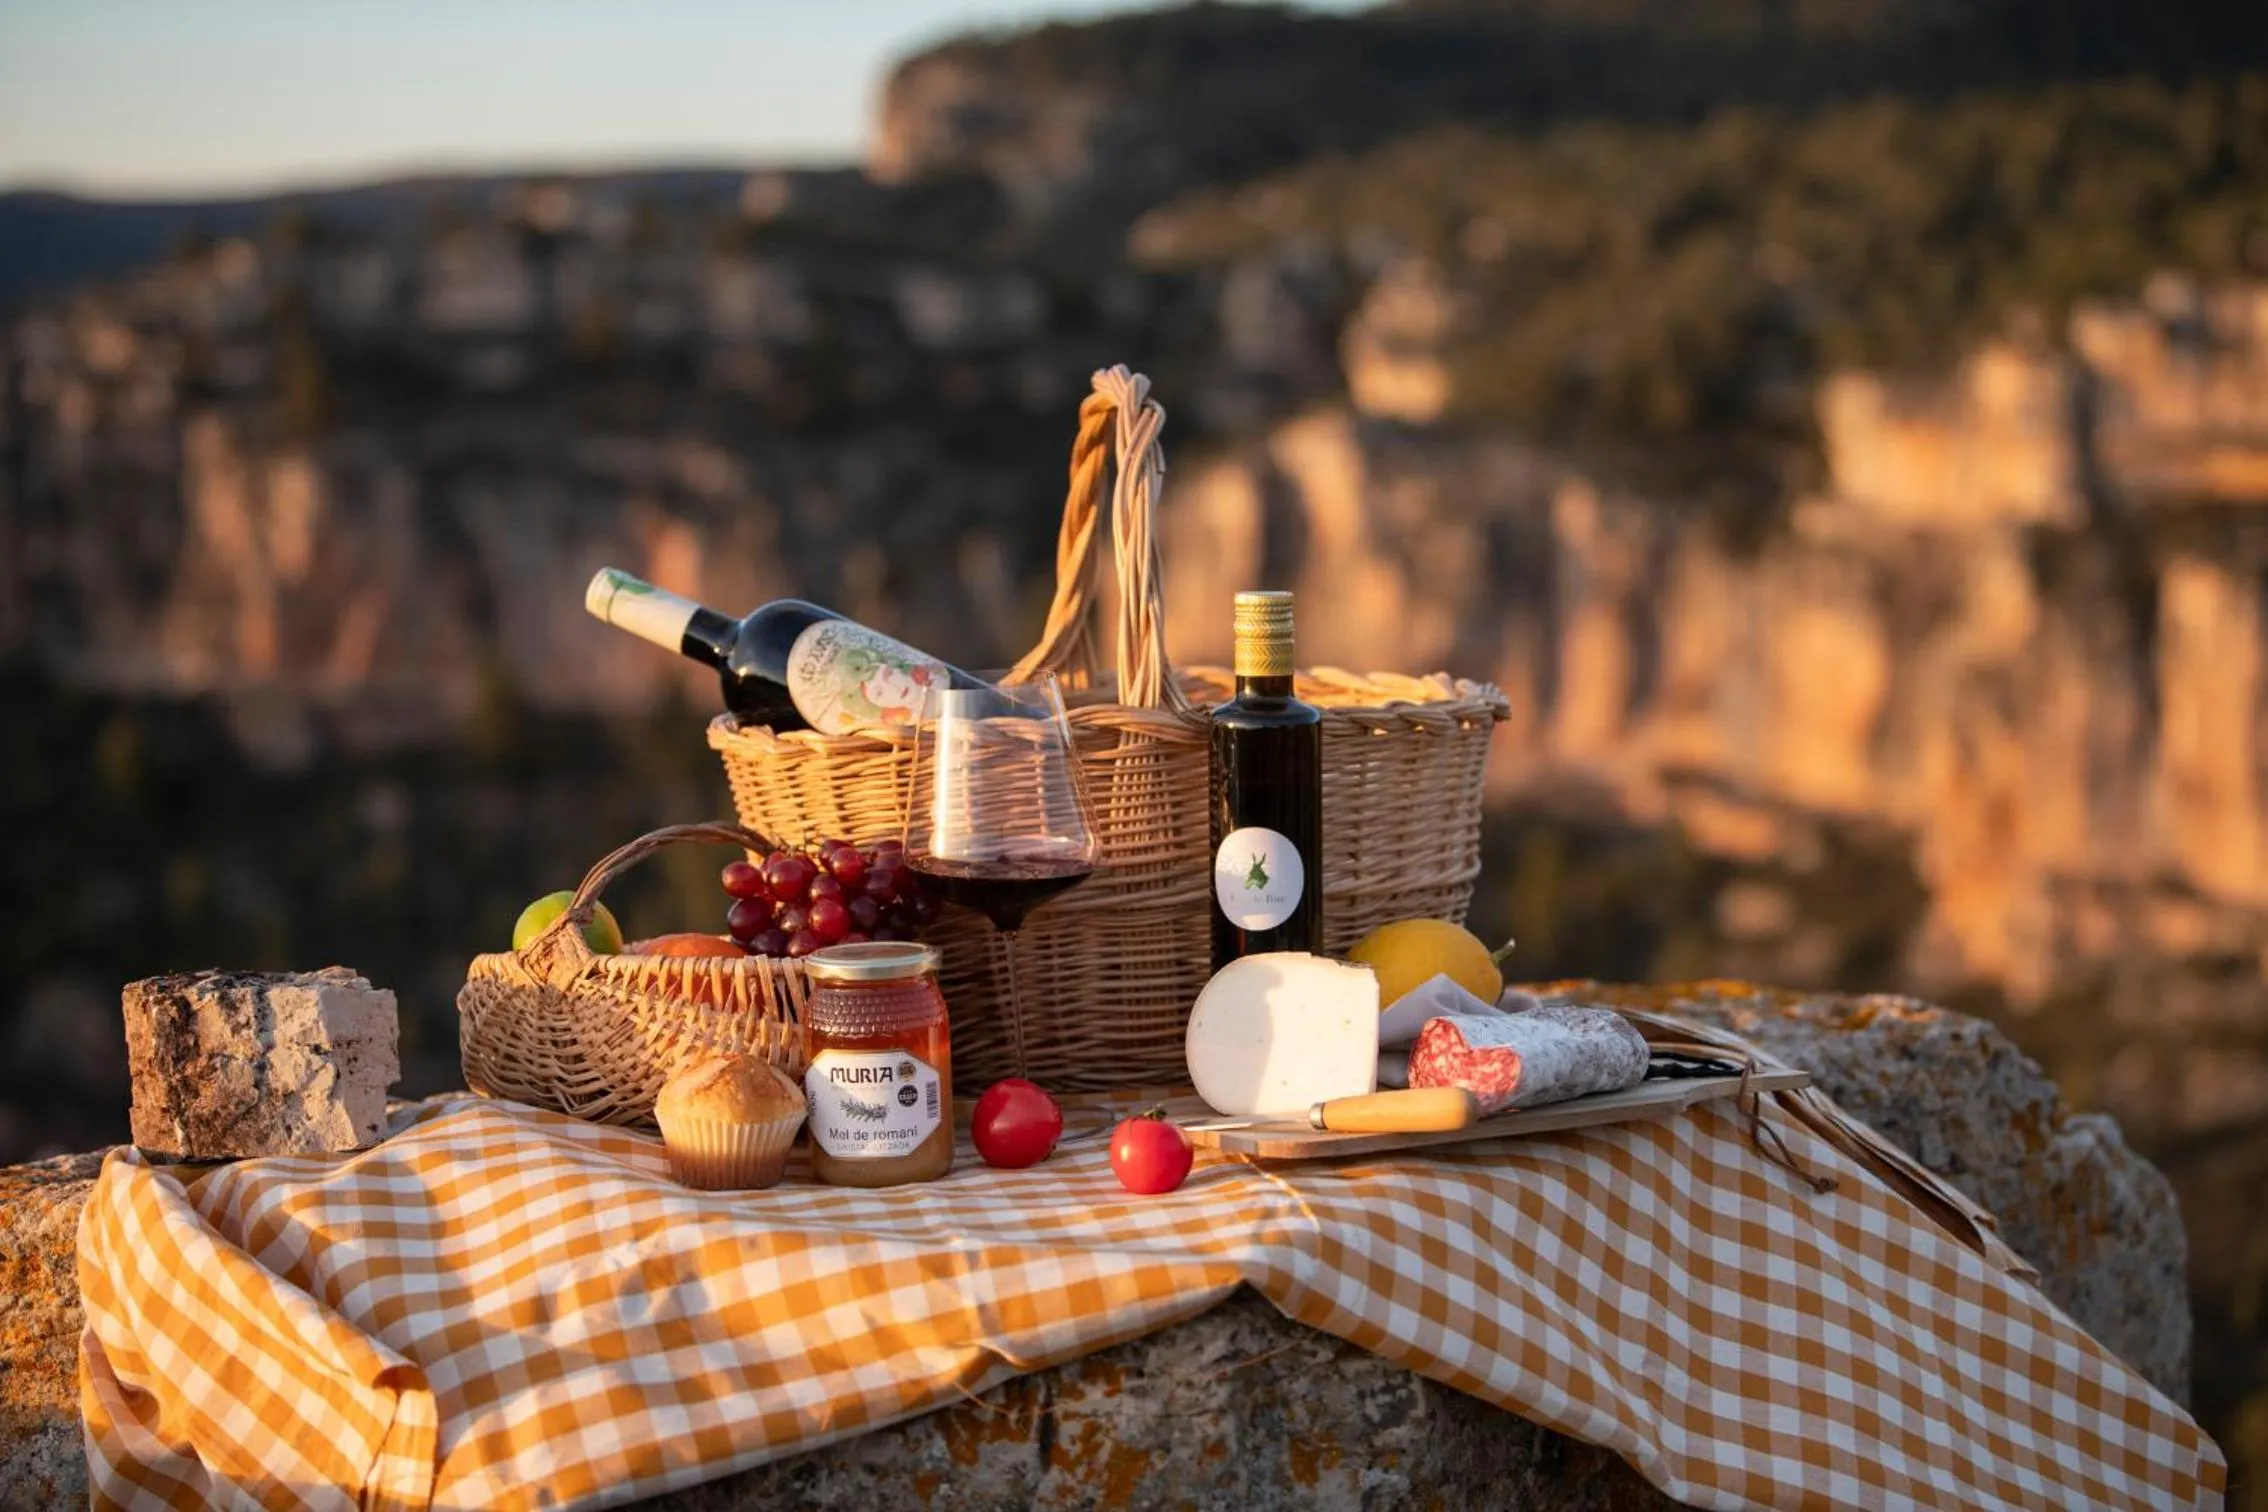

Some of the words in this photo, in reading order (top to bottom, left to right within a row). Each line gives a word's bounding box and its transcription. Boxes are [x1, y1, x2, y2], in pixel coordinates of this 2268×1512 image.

[830, 1067, 893, 1083] MURIA
[829, 1127, 849, 1140] Mel
[853, 1128, 869, 1141] de
[873, 1125, 918, 1140] romani
